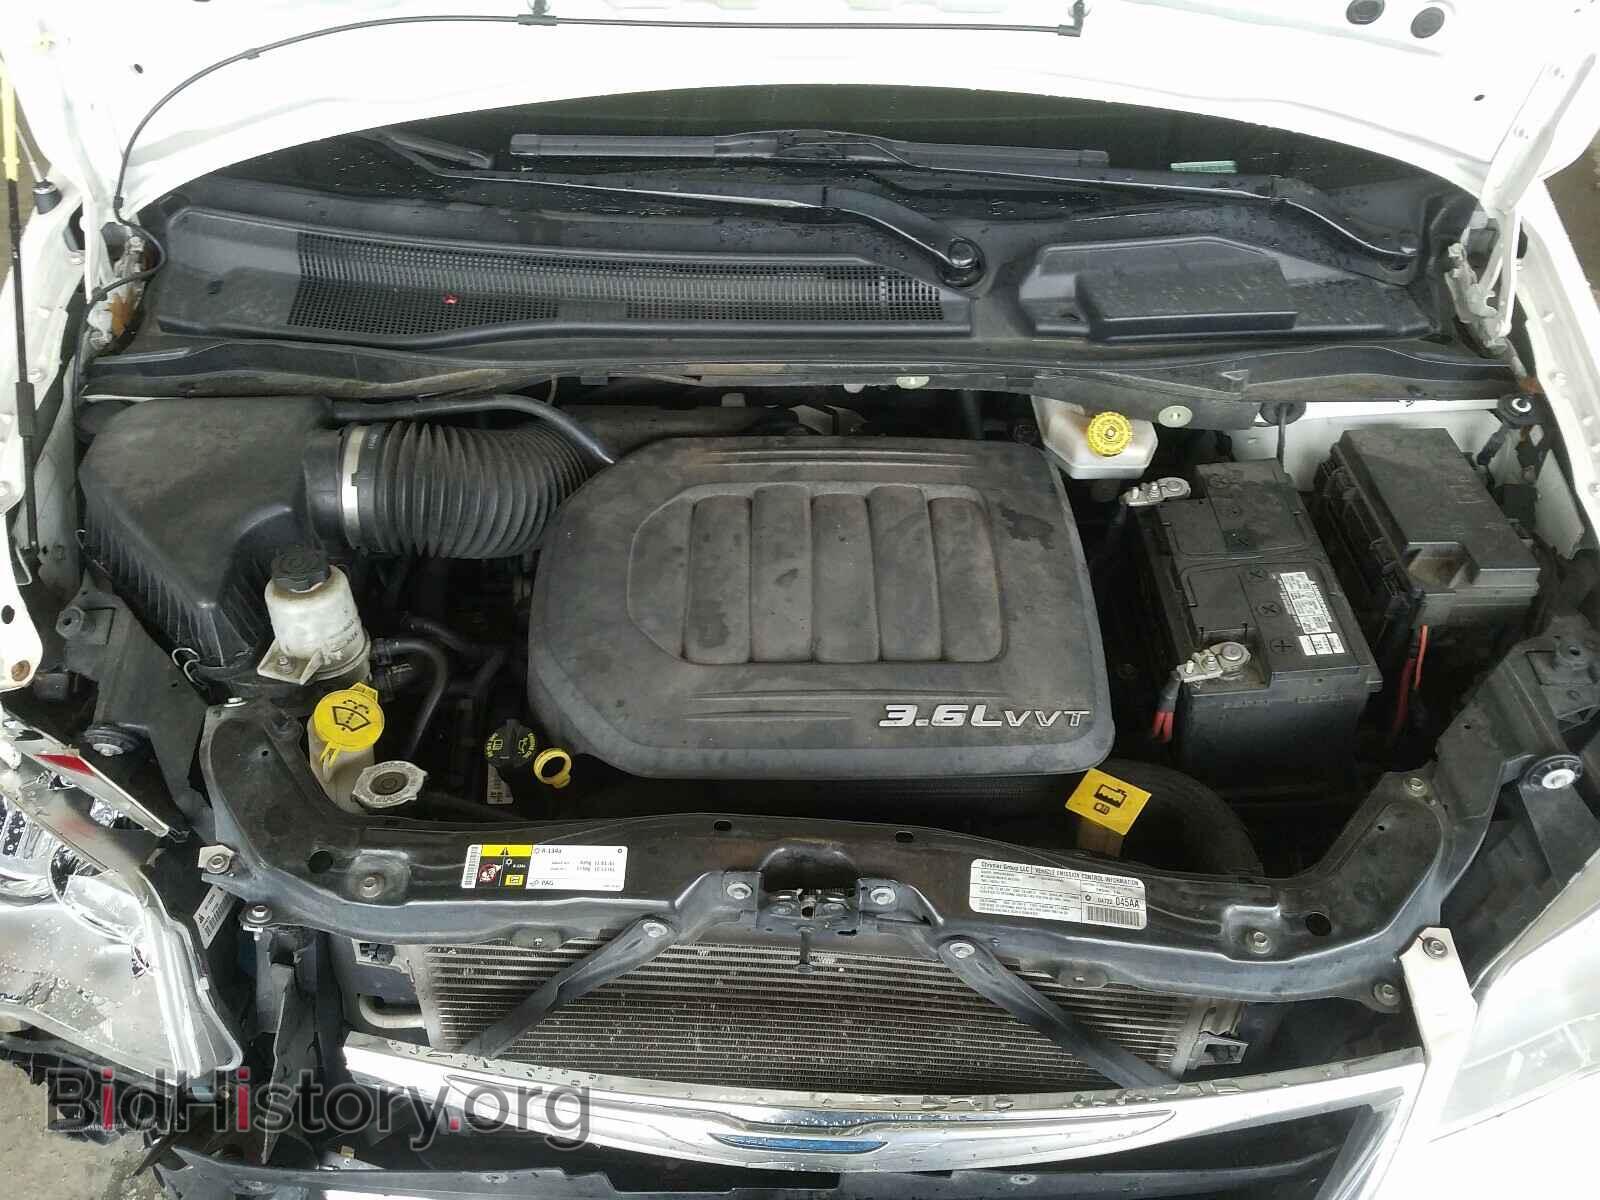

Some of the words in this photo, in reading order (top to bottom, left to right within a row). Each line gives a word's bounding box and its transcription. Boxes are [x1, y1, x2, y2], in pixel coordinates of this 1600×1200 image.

[879, 704, 1002, 727] 3.6L
[1004, 710, 1090, 727] VVT
[1057, 870, 1080, 878] EMISSION
[1081, 873, 1103, 882] CONTROL
